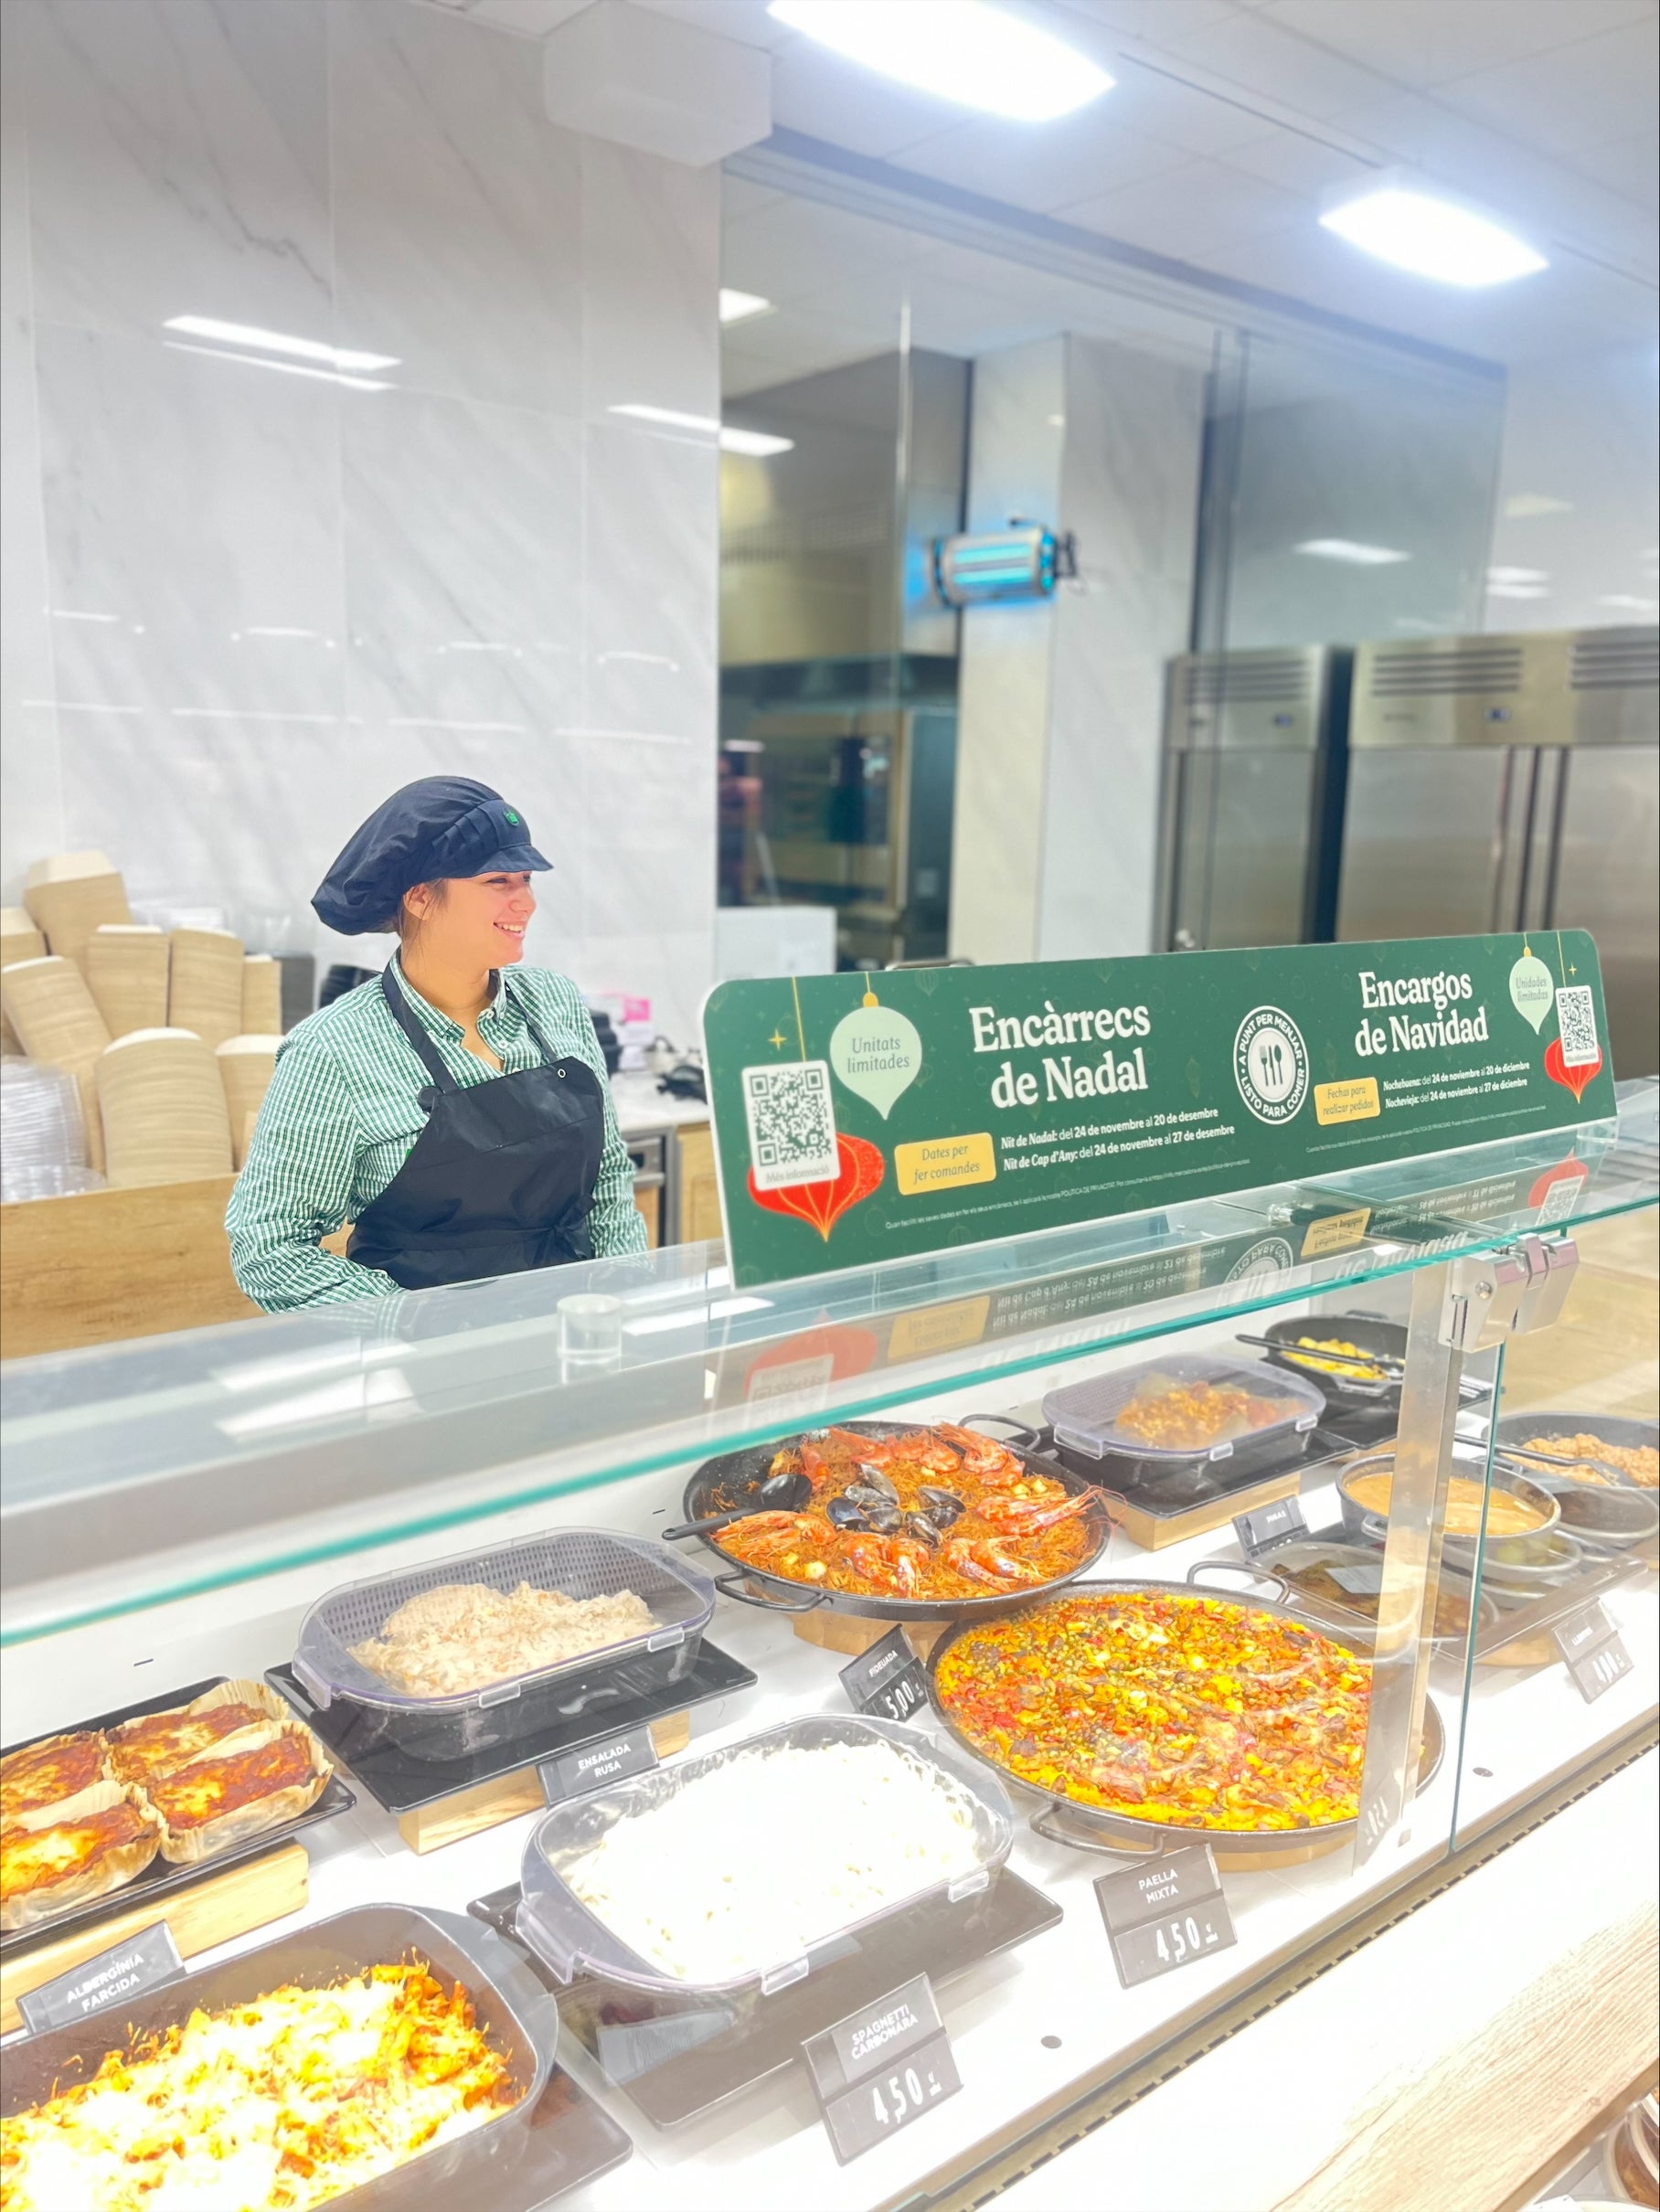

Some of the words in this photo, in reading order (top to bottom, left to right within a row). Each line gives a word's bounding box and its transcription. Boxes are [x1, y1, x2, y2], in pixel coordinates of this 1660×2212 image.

[1358, 971, 1474, 1011] Encargos
[969, 1000, 1151, 1053] Encàrrecs
[1255, 1014, 1273, 1027] PER
[1355, 1020, 1386, 1057] de
[1389, 1005, 1489, 1053] Navidad
[851, 1037, 901, 1054] Unitats
[1239, 1020, 1257, 1053] PUNT
[1274, 1016, 1303, 1060] MENJAR
[846, 1056, 910, 1074] limitades
[1239, 1055, 1247, 1066] A
[1383, 1079, 1421, 1091] Nochebuena:
[1421, 1075, 1431, 1086] del
[1431, 1073, 1441, 1084] 24
[1441, 1072, 1449, 1082] de
[1449, 1068, 1481, 1081] noviembre
[1485, 1065, 1494, 1075] 20
[1494, 1064, 1502, 1074] de
[1503, 1060, 1530, 1073] diciembre
[991, 1061, 1038, 1109] de
[1042, 1048, 1149, 1102] Nadal
[1240, 1076, 1262, 1110] LISTO
[1262, 1103, 1288, 1117] PARA
[1286, 1068, 1305, 1111] COMER
[1327, 1088, 1349, 1100] Fechas
[1385, 1094, 1420, 1109] Nochevieja:
[1420, 1092, 1430, 1103] del
[1430, 1090, 1439, 1101] 24
[1439, 1090, 1447, 1100] de
[1447, 1085, 1479, 1099] noviembre
[1484, 1081, 1492, 1092] 27
[1492, 1080, 1500, 1091] de
[1500, 1077, 1528, 1090] diciembre
[1323, 1103, 1348, 1116] realizar
[1001, 1136, 1015, 1150] Nit
[1016, 1135, 1027, 1147] de
[1028, 1130, 1058, 1145] Nadal:
[1059, 1128, 1073, 1141] del
[1074, 1125, 1086, 1138] 24
[1087, 1124, 1100, 1136] de
[1101, 1119, 1144, 1134] novembre
[1145, 1116, 1153, 1128] al
[1154, 1113, 1165, 1126] 20
[1166, 1112, 1178, 1124] de
[1178, 1108, 1218, 1122] desembre
[921, 1146, 950, 1162] Dates
[951, 1144, 969, 1160] per
[1004, 1157, 1017, 1171] Nit
[1018, 1156, 1030, 1168] de
[1031, 1154, 1049, 1167] Cap
[1079, 1146, 1093, 1158] del
[1094, 1143, 1106, 1156] 24
[1107, 1142, 1119, 1154] de
[1120, 1136, 1164, 1152] novembre
[1164, 1133, 1172, 1145] al
[1172, 1132, 1183, 1143] 27
[1184, 1131, 1195, 1142] de
[1196, 1124, 1236, 1140] desembre
[913, 1168, 929, 1185] fer
[930, 1161, 980, 1179] comandes
[868, 1650, 898, 1678] FIDEUADA
[578, 1743, 632, 1770] ENSALADA
[594, 1760, 622, 1778] RUSA
[1138, 1868, 1178, 1890] PAELLA
[1145, 1884, 1179, 1904] MIXTA
[67, 1953, 144, 2004] ALBERGÍNIA
[81, 1973, 141, 2012] FARCIDA
[851, 2004, 910, 2046] SPAGHETTI
[851, 2014, 919, 2060] CARBONARA
